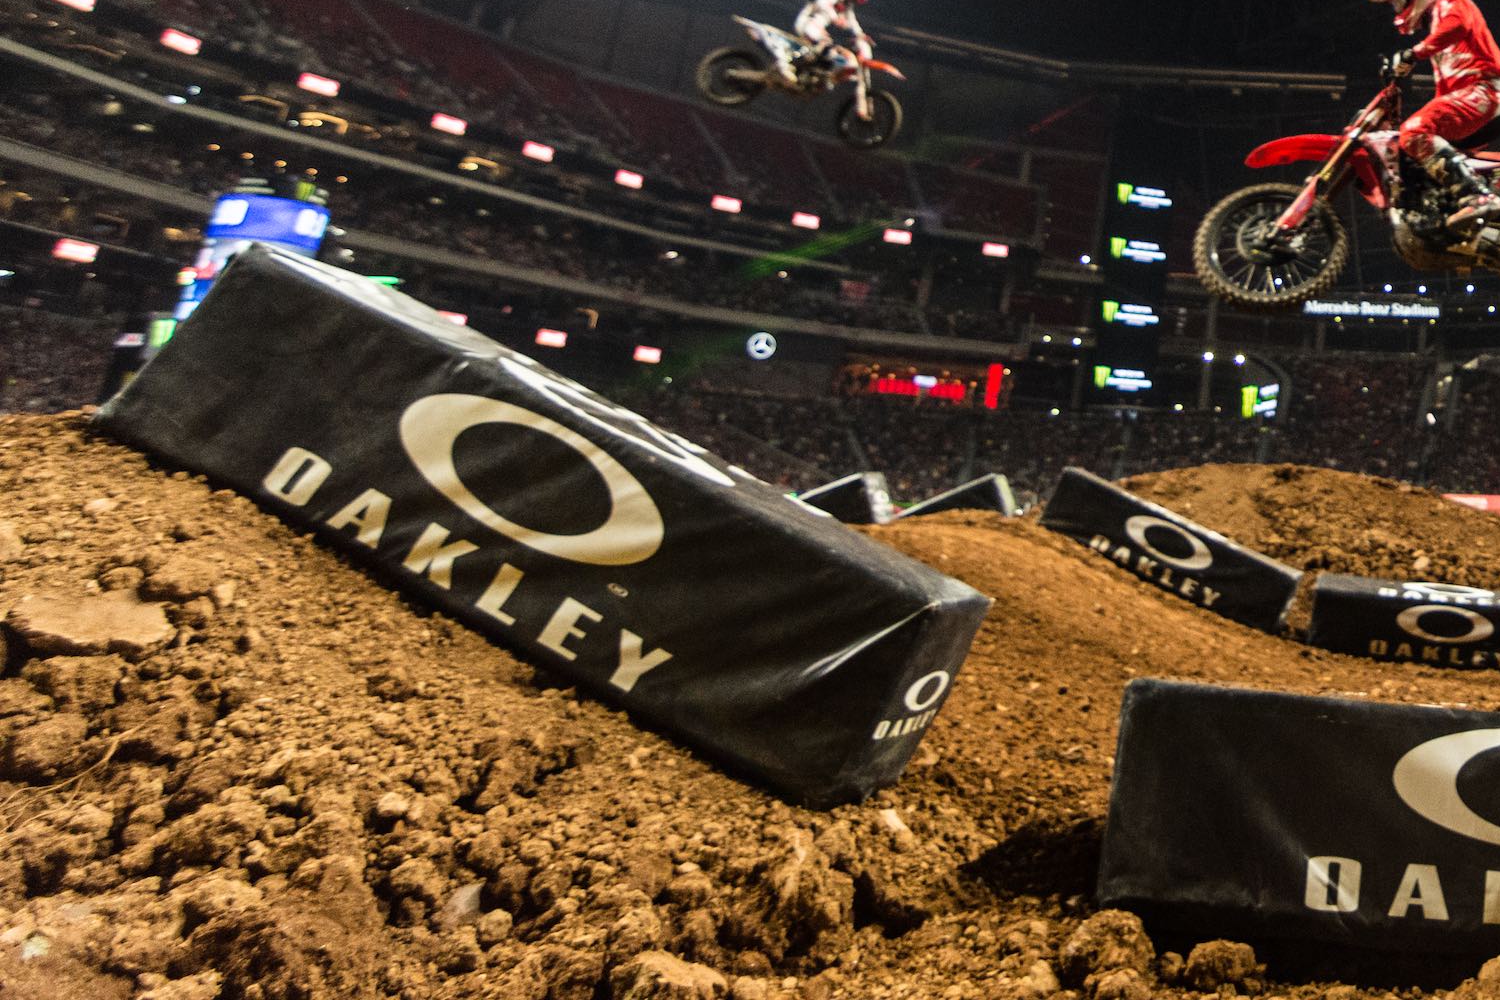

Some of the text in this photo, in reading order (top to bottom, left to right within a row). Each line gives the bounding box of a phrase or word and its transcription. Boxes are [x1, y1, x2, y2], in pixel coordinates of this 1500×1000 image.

[1391, 301, 1440, 318] Stadium
[263, 446, 674, 693] OAKLEY
[1089, 534, 1222, 607] OAKLEY
